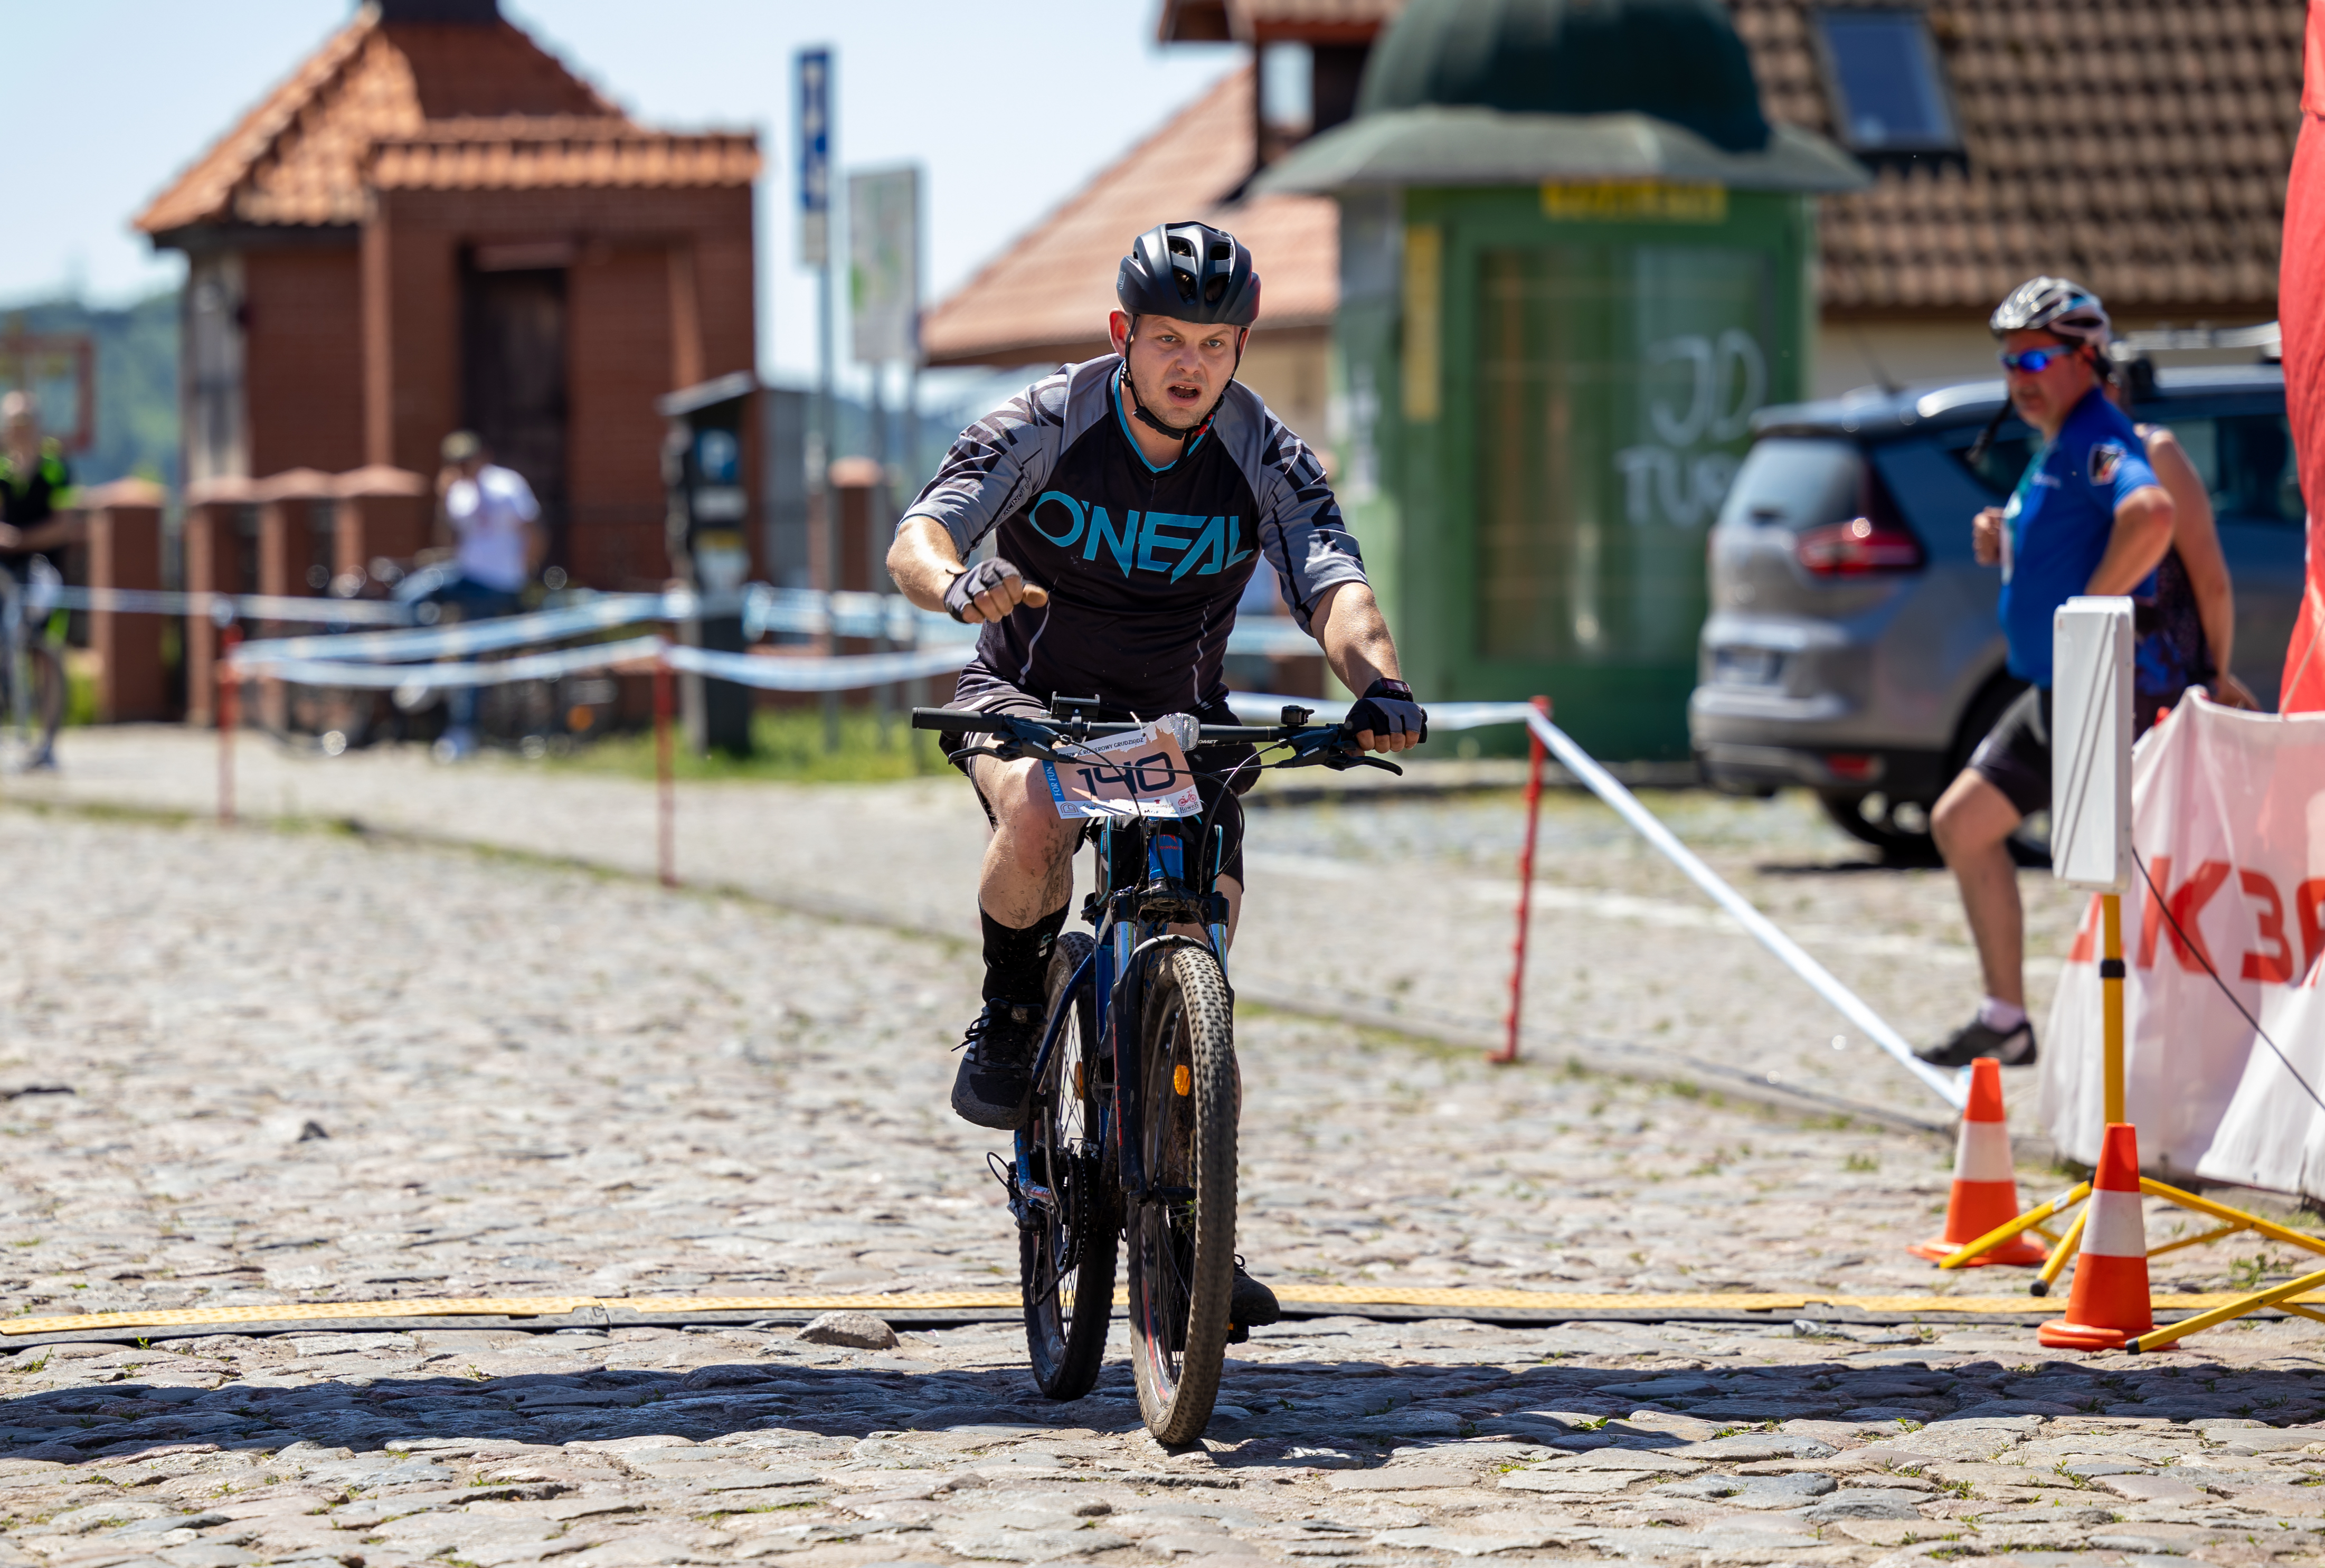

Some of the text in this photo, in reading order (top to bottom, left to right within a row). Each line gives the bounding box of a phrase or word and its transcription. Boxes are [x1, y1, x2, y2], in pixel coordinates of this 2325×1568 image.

[1029, 490, 1253, 585] O'NEAL
[1045, 766, 1062, 796] FOR FUN
[1076, 751, 1176, 796] 140
